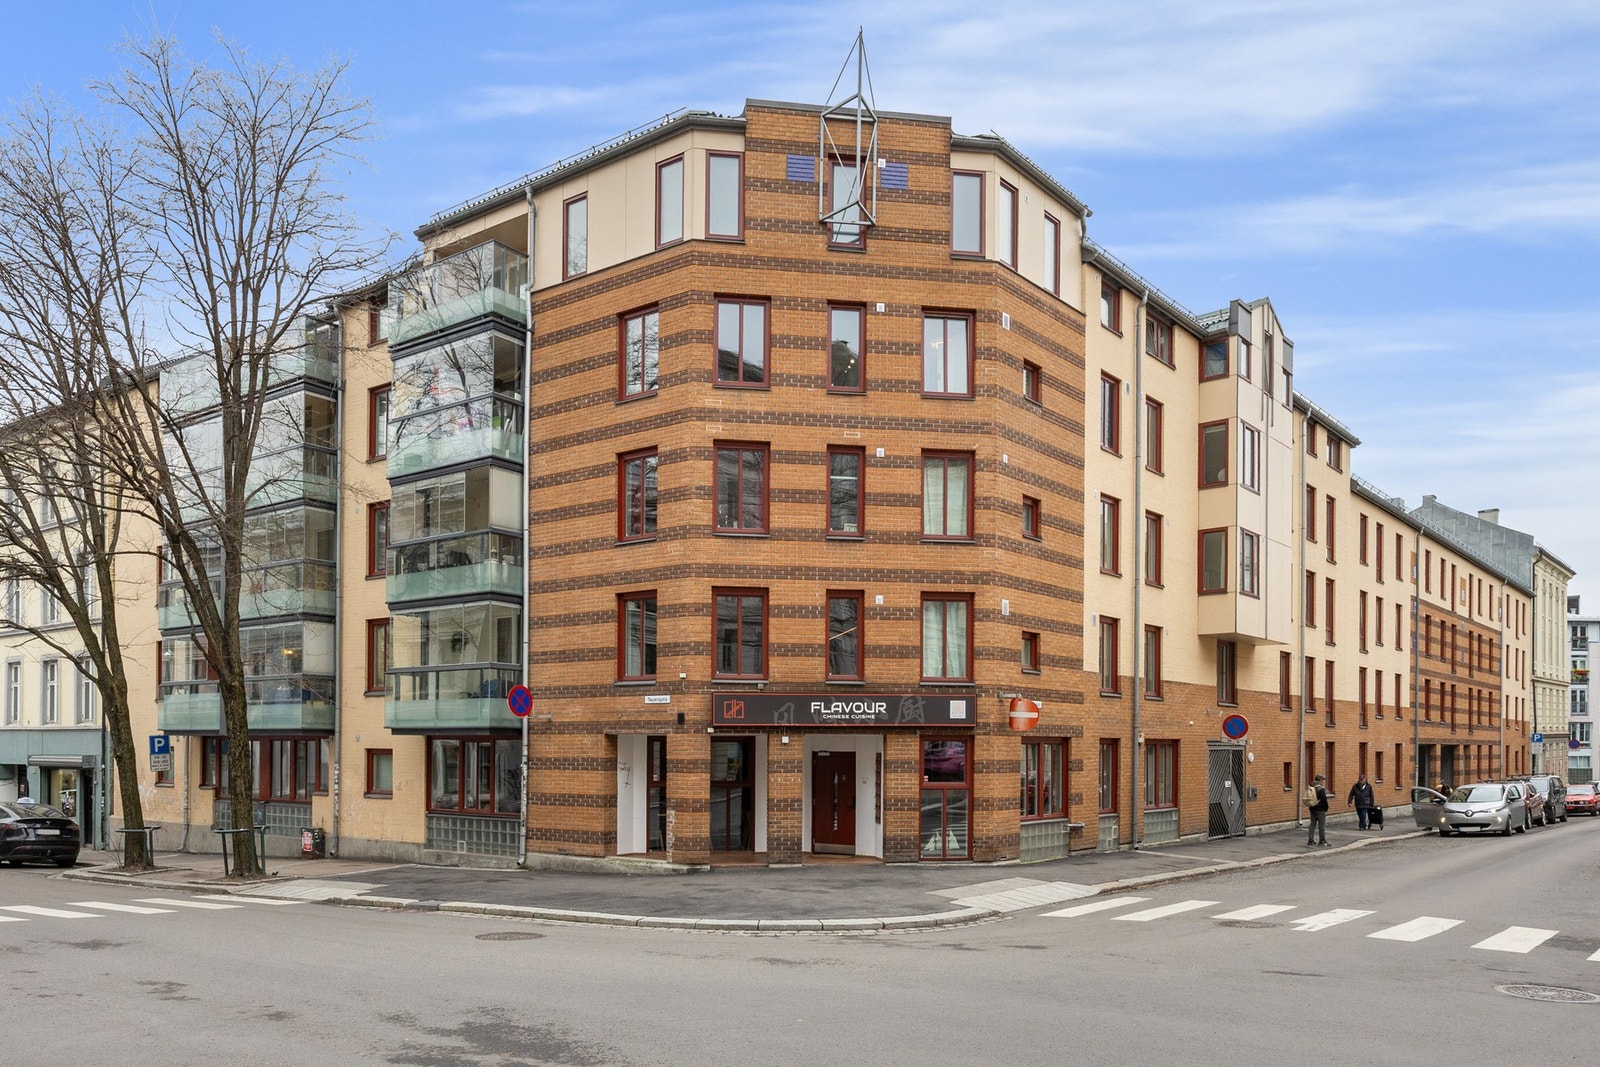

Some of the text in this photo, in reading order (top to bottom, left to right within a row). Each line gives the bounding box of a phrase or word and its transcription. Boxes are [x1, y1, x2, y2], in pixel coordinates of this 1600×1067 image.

[811, 702, 887, 713] FLAVOUR
[1534, 734, 1541, 742] P
[154, 737, 165, 752] P
